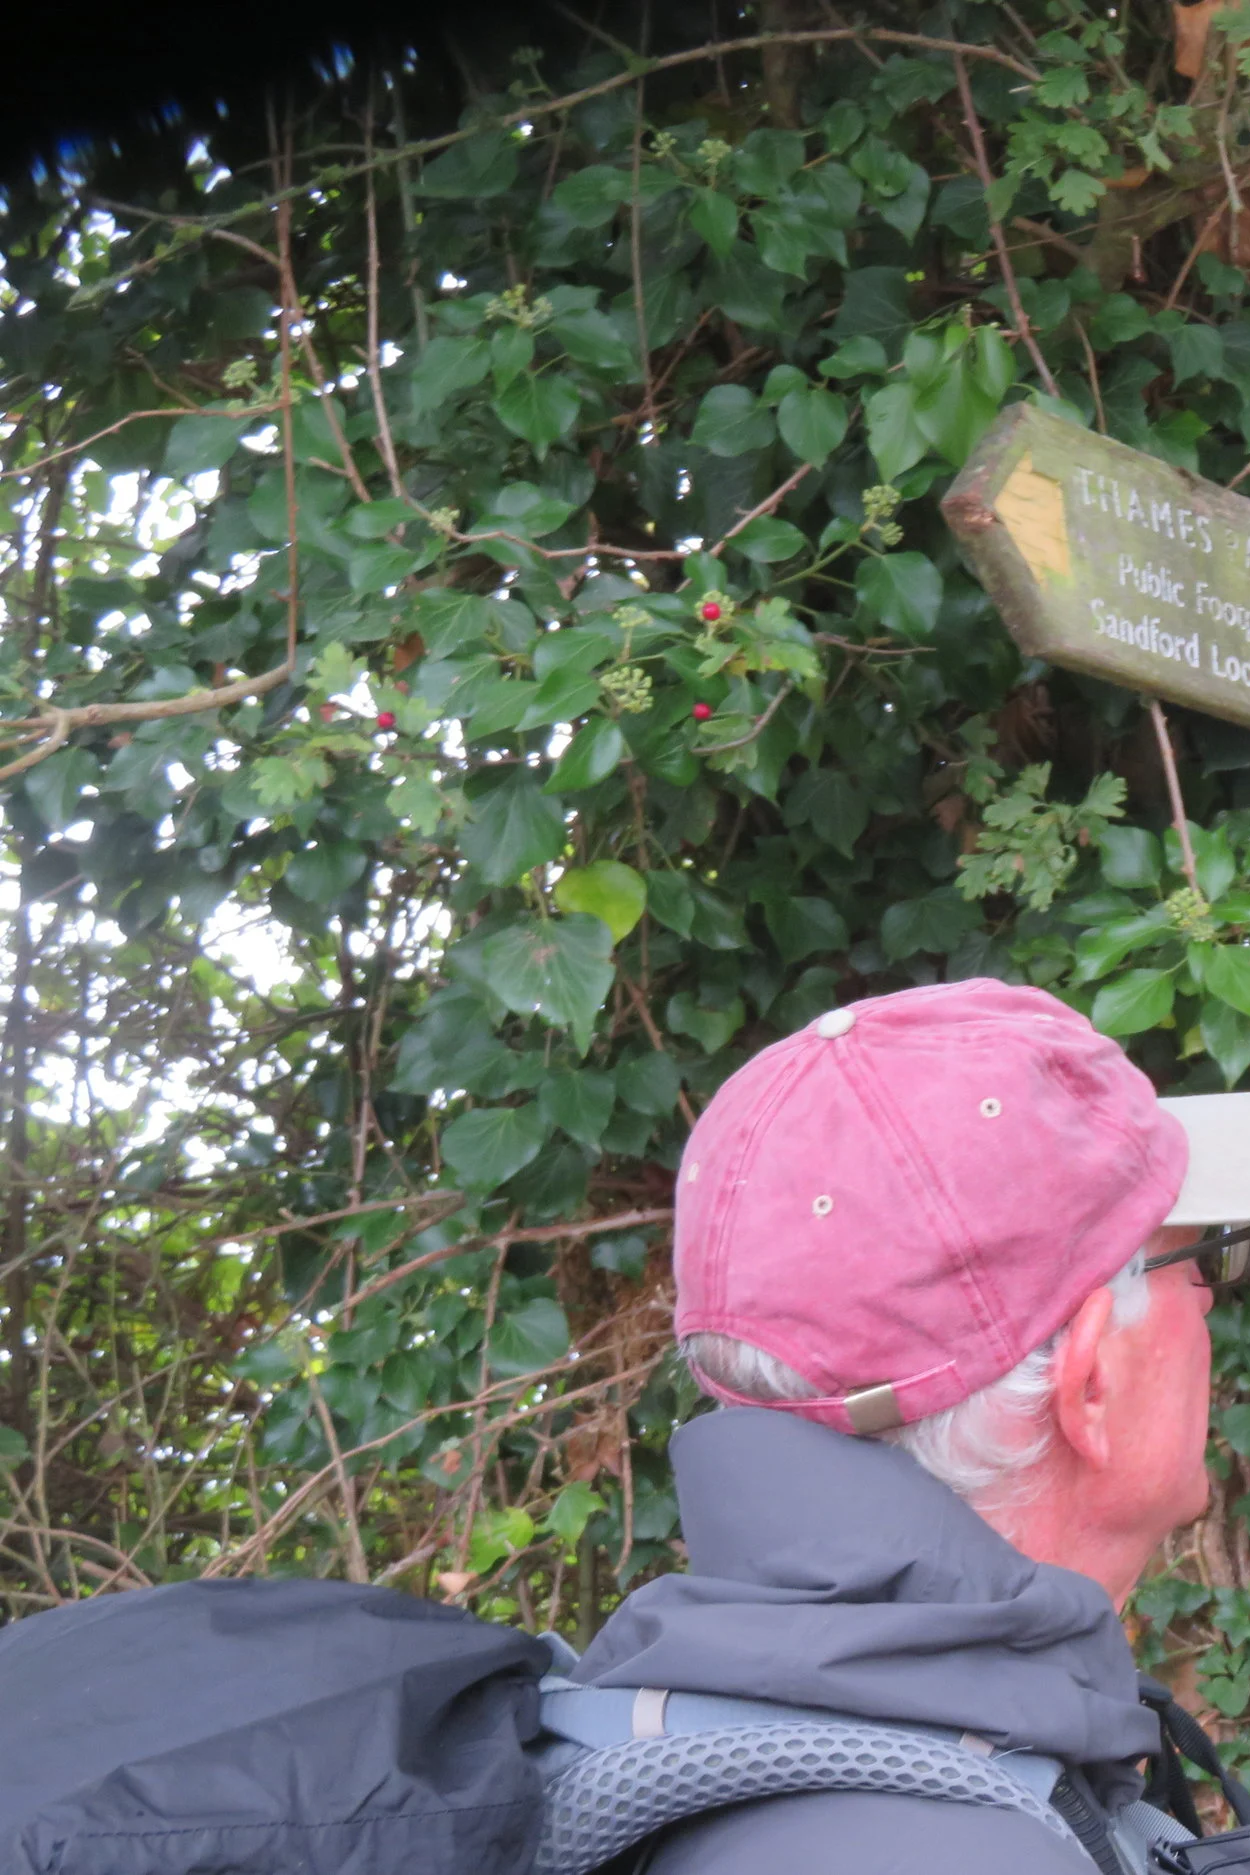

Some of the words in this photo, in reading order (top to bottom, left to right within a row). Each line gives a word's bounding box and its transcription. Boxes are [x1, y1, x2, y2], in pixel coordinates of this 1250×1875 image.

[1074, 466, 1214, 554] THAMES
[1118, 553, 1186, 608] Public
[1089, 597, 1200, 669] Sandford
